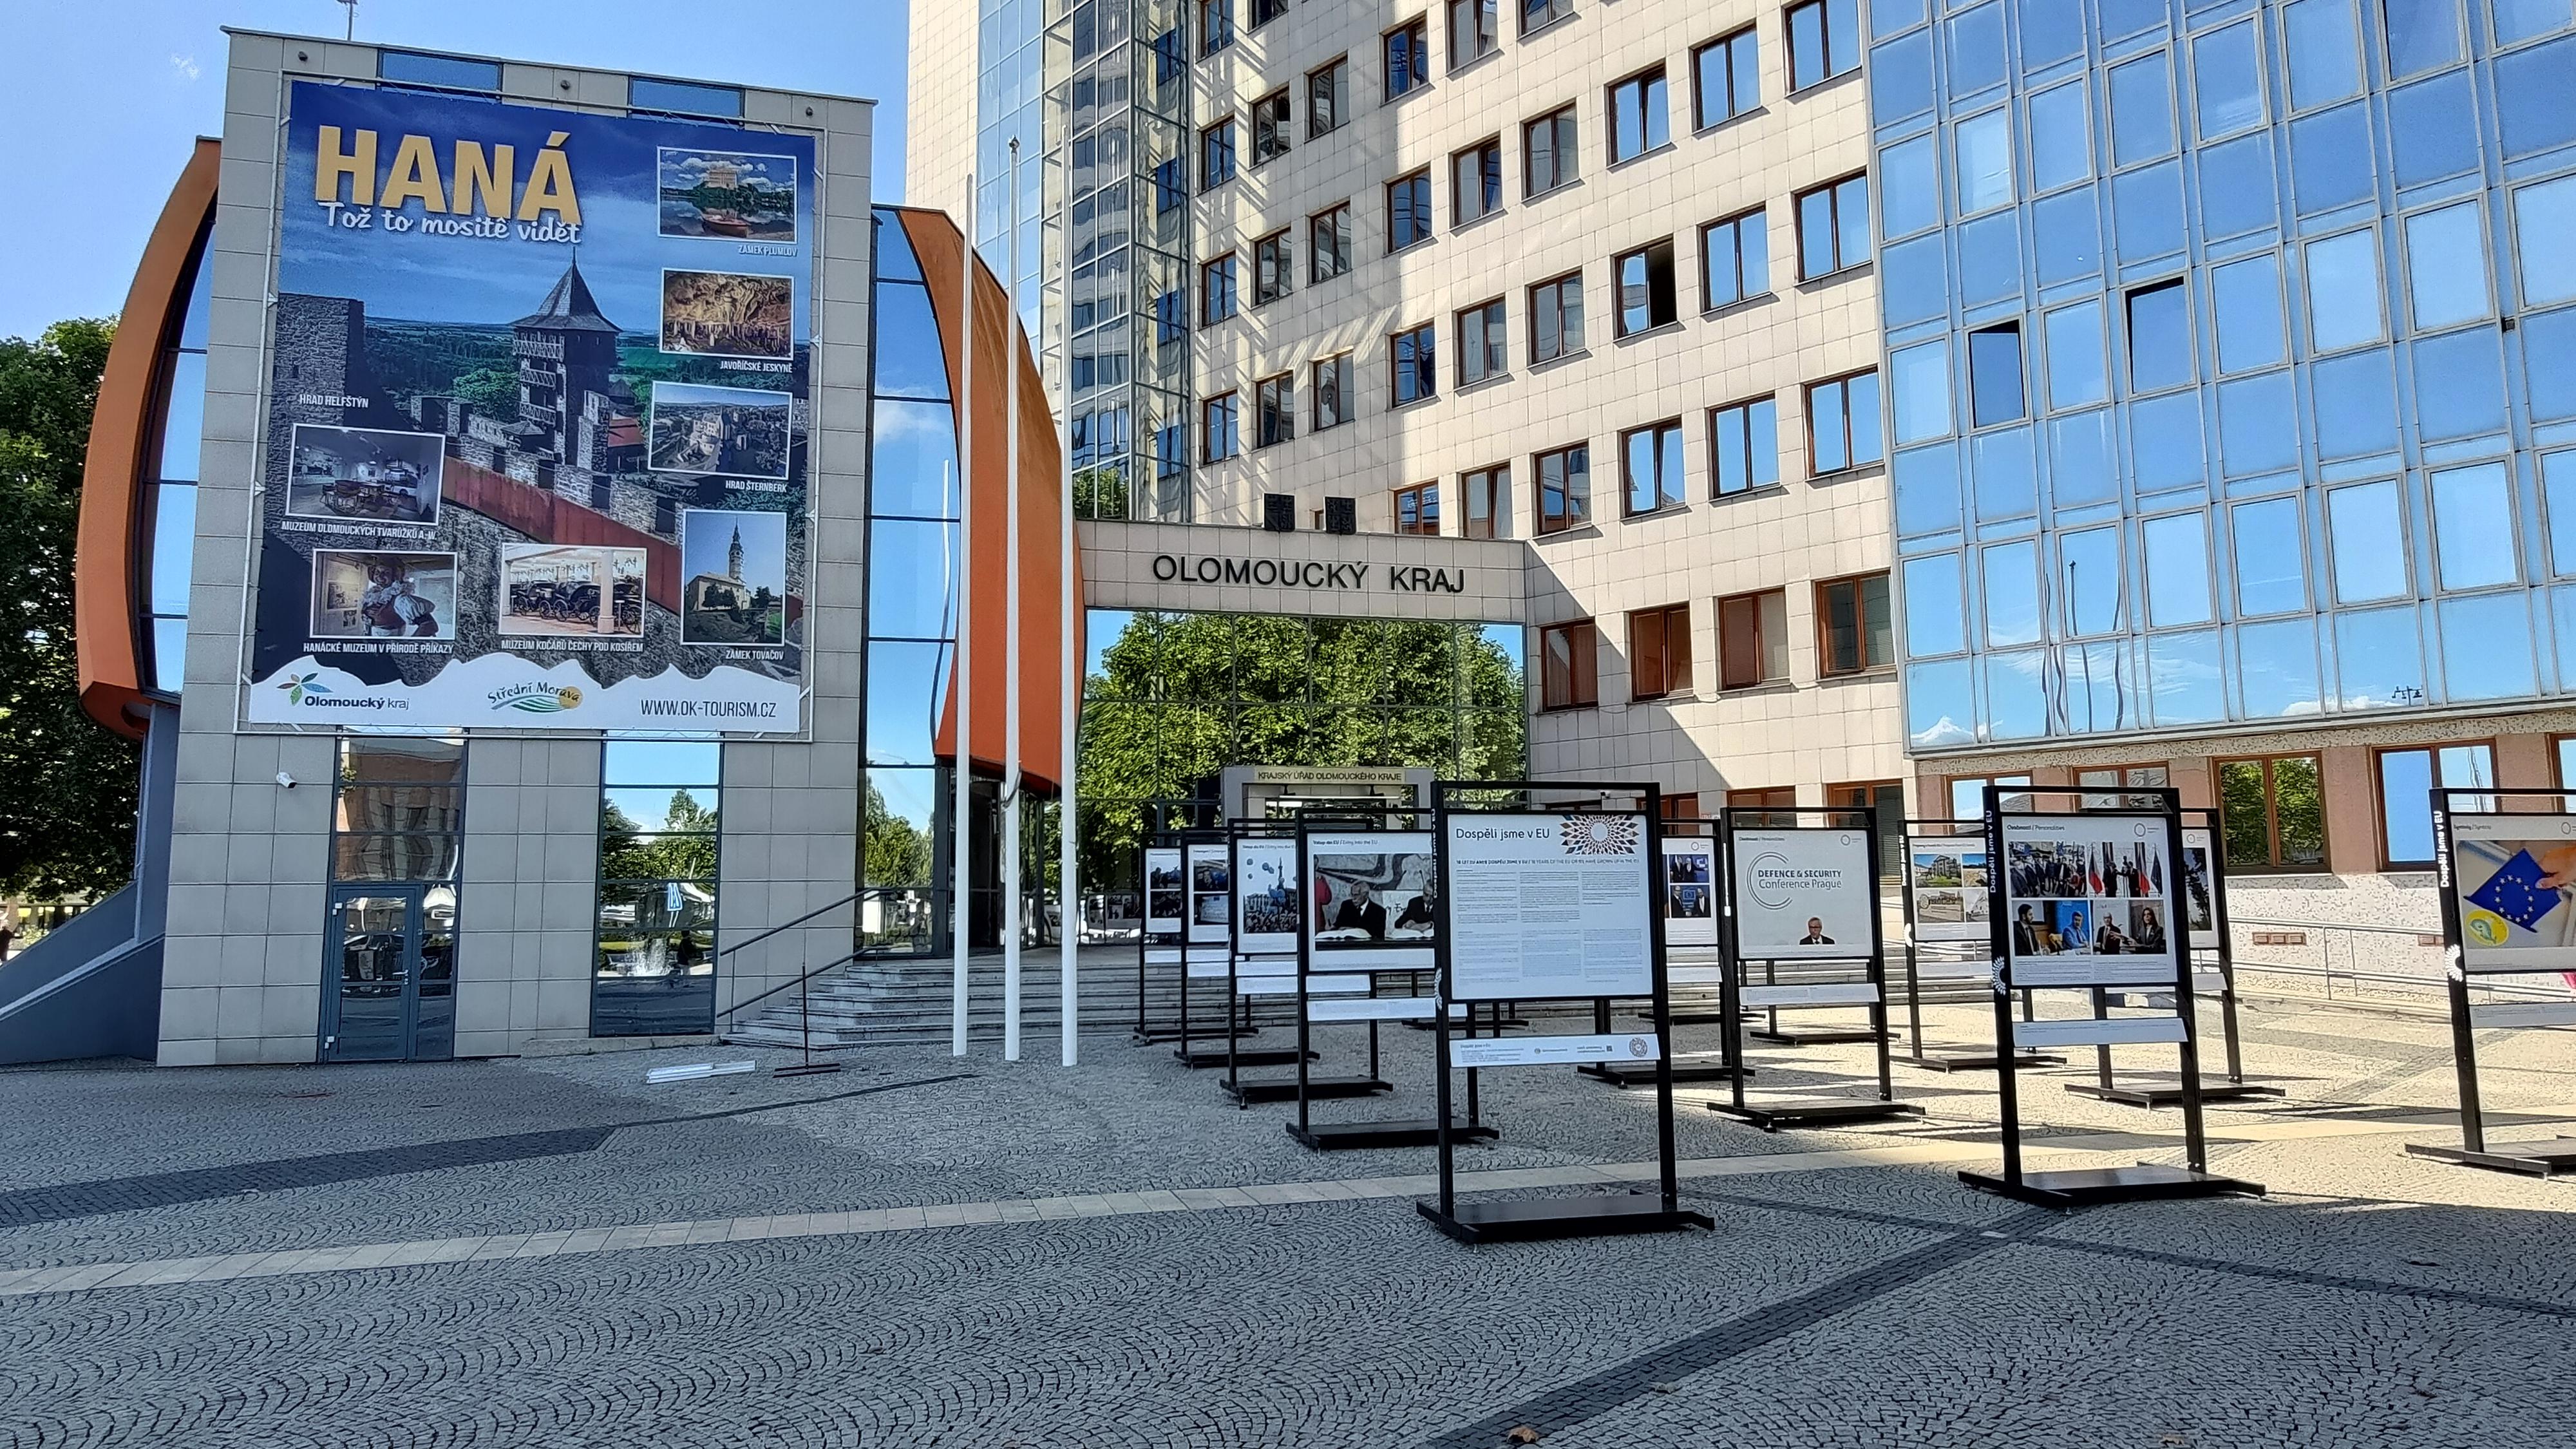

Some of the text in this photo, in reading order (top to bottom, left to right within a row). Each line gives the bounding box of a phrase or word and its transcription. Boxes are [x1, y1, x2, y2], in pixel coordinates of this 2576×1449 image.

[315, 125, 582, 226] HANÁ
[317, 200, 372, 229] Tož
[381, 209, 413, 232] to
[518, 216, 582, 243] vidět
[738, 244, 798, 257] ZÁMEK PLUMLOV
[720, 360, 793, 373] JAVOŘÍČSKÉ JESKYNĚ
[299, 393, 369, 408] HRAD HELFŠTÝN
[725, 480, 787, 493] HRAD ŠTERNBERK
[281, 520, 316, 533] MUZEUM
[317, 522, 377, 536] OLOMOUCKÝCH
[377, 525, 417, 539] TVARŮŽKŮ
[428, 530, 437, 540] W.
[1152, 554, 1465, 593] OLOMOUCKÝ KRAJ
[303, 642, 453, 655] HANÁCKÉ MUZEUM V PŘÍRODĚ PŘÍKAZY
[501, 639, 643, 652] MUZEUM KOČÁRŮ ČECHY POD KOSÍŘEM
[725, 649, 784, 660] ZÁMEK TOVAČOV
[488, 682, 582, 704] Střední Morava
[305, 696, 410, 710] Olomoucký kraj
[641, 699, 777, 718] WWW.OK-TOURISM.CZ
[1258, 770, 1293, 781] KRAJSKÝ
[1316, 771, 1377, 781] OLOMOUCKÉHO
[1378, 772, 1402, 781] KRAJE
[1985, 810, 1993, 823] EU
[2434, 810, 2443, 824] EU
[1456, 828, 1497, 841] Dospěli
[1500, 828, 1525, 841] jsme
[1536, 829, 1550, 838] EU
[1987, 832, 1996, 855] jsme
[2437, 831, 2448, 853] jsme
[1988, 857, 1996, 893] Dospěli
[2438, 853, 2450, 887] Dospěli
[1759, 878, 1841, 891] Conference Prague
